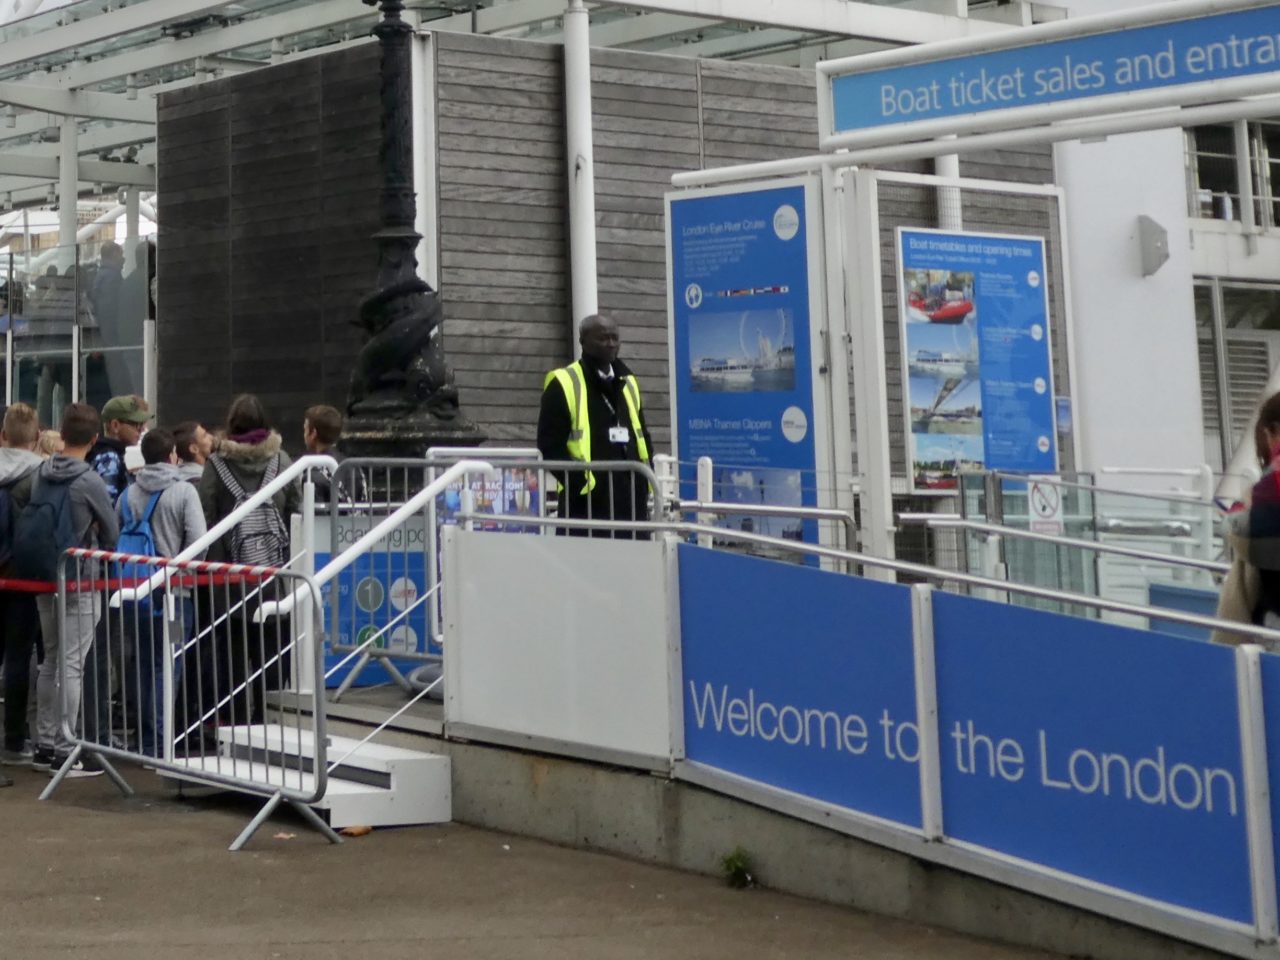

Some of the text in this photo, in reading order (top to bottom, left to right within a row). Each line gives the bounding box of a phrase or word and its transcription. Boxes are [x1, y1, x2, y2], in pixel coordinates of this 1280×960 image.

[881, 33, 1280, 117] Boat ticket sales and entra
[471, 481, 525, 490] ATRACION
[689, 680, 1238, 816] Welcome to the London
